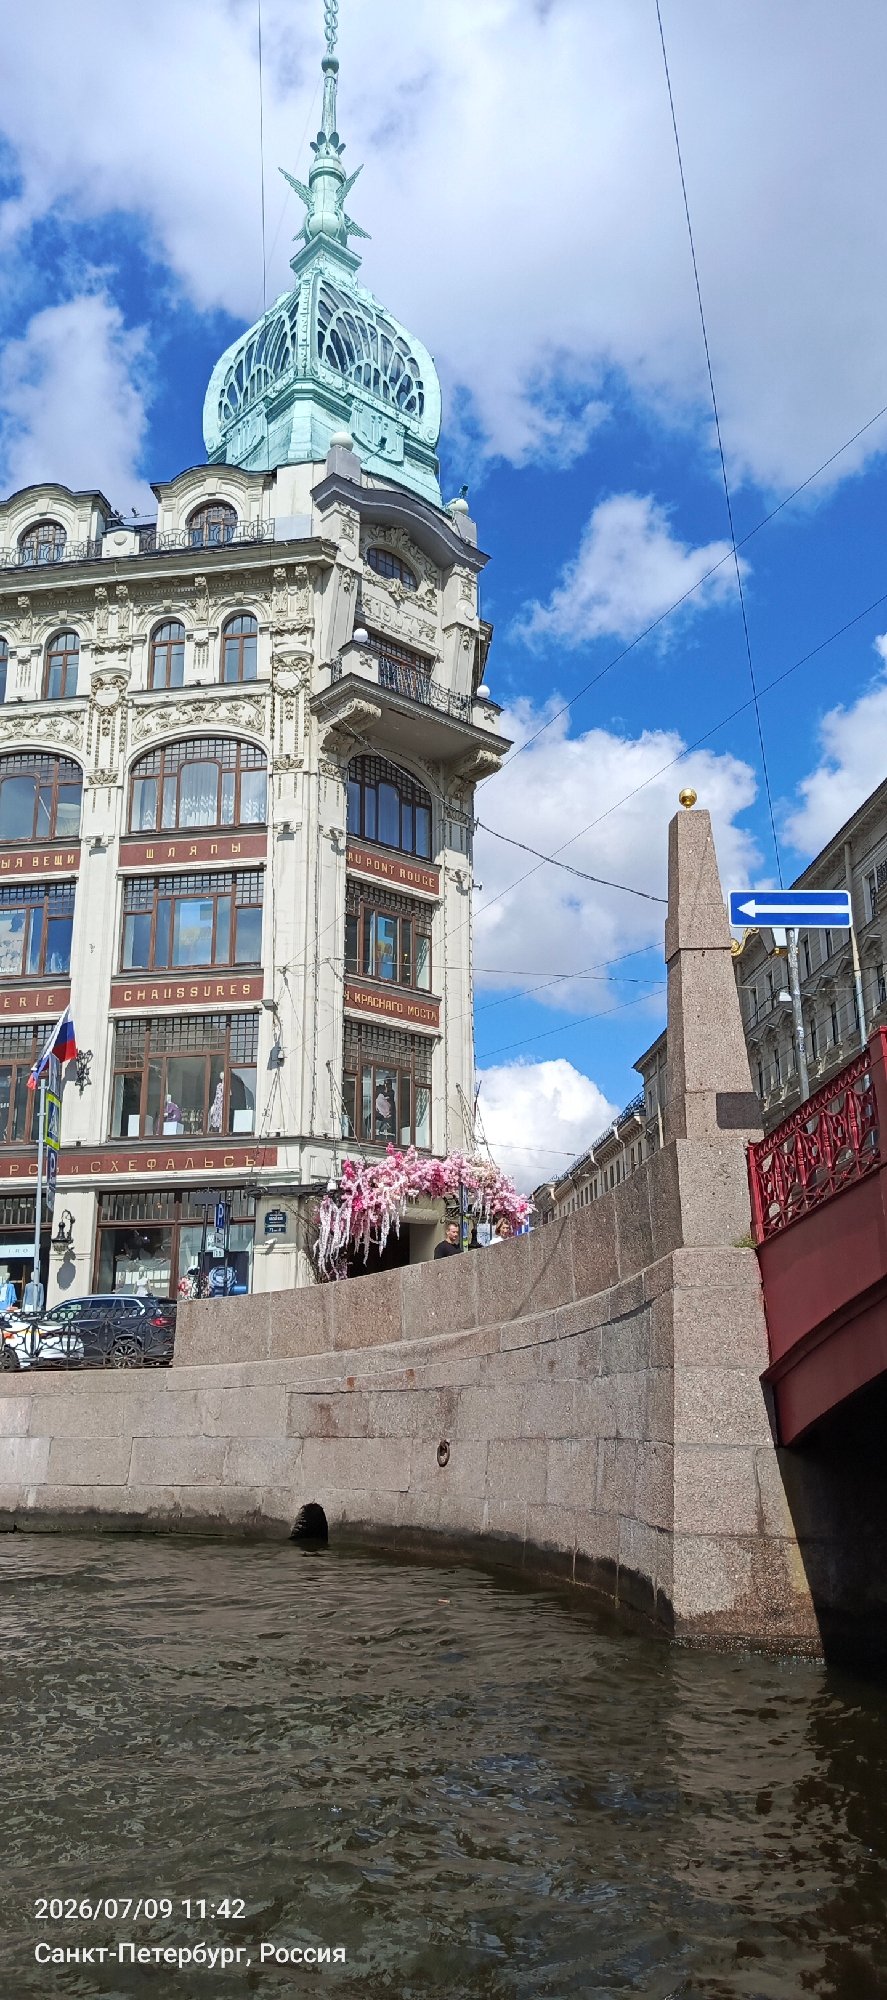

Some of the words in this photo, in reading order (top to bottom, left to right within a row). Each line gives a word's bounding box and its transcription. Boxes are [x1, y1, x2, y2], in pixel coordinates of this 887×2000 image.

[146, 843, 241, 859] ШЛЯПЫ
[0, 857, 23, 869] ЫЯ
[32, 854, 75, 867] ВЕЩИ
[348, 852, 362, 865] AU
[366, 857, 395, 875] PONT
[399, 868, 435, 888] ROUGE
[0, 993, 55, 1008] ERIE
[124, 984, 251, 1002] CHAUSSURES
[354, 992, 403, 1013] КРАСНАГО
[407, 1005, 438, 1022] МОСТА
[90, 1155, 256, 1173] СХЕФАЛЬСЪ
